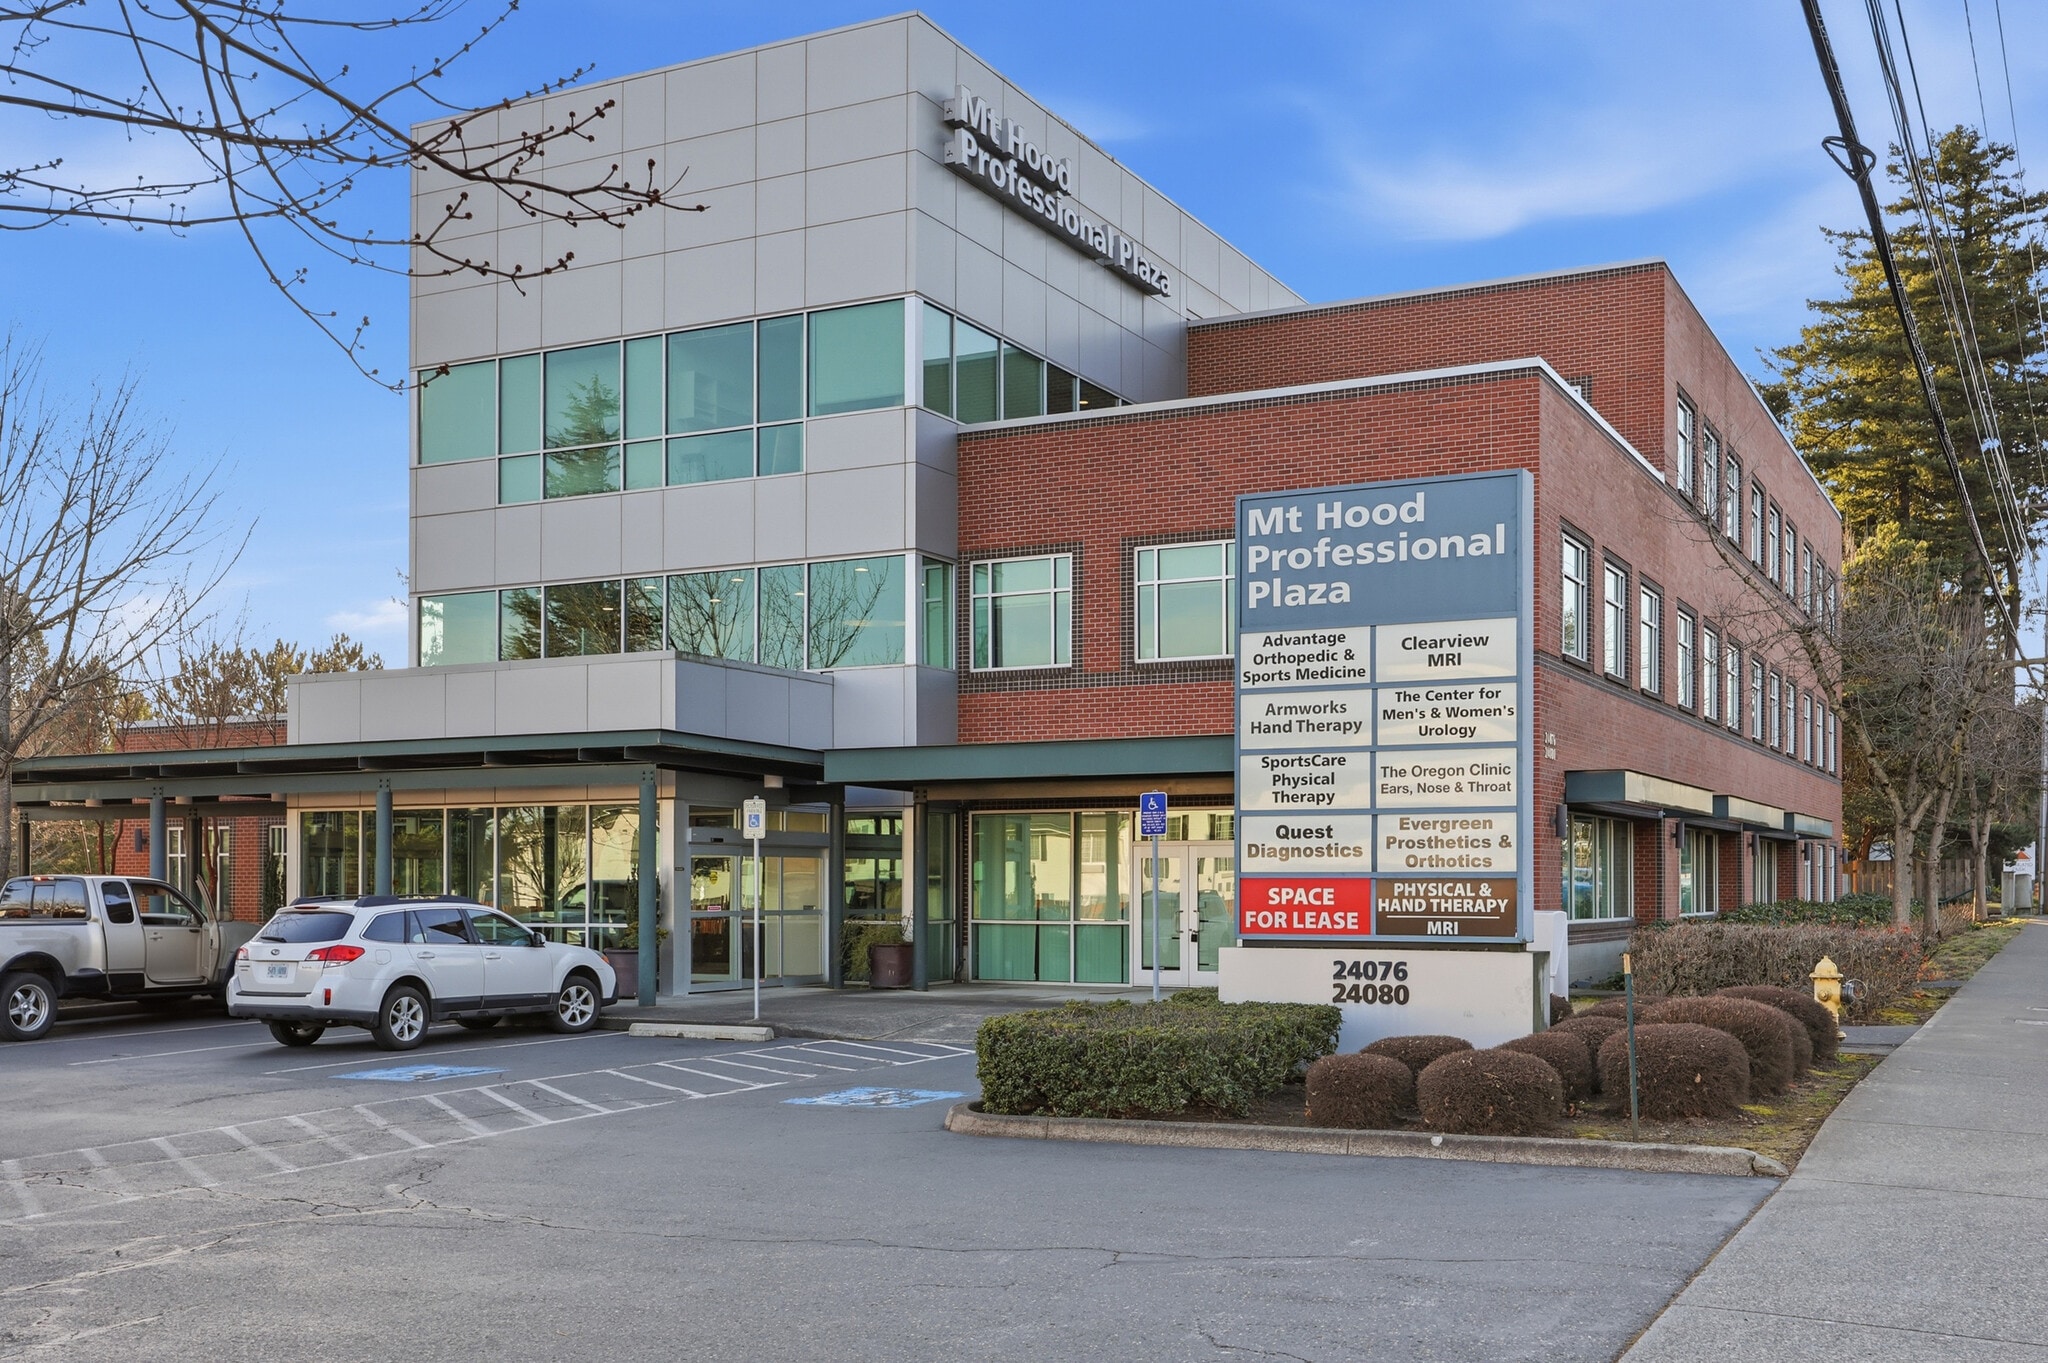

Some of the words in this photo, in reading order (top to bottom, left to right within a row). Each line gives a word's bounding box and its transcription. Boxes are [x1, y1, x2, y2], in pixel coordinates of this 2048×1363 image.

[956, 84, 1001, 148] Mt
[1003, 118, 1071, 195] Hood
[955, 128, 1113, 260] Professional
[1114, 235, 1171, 296] Plaza
[1248, 506, 1302, 536] Mt
[1316, 491, 1425, 530] Hood
[1248, 523, 1505, 573] Professional
[1248, 578, 1351, 608] Plaza
[1262, 632, 1346, 647] Advantage
[1401, 634, 1489, 650] Clearview
[1253, 650, 1338, 667] Orthopedic
[1344, 649, 1355, 661] &
[1428, 653, 1462, 667] MRI
[1243, 670, 1291, 686] Sports
[1296, 666, 1366, 680] Medicine
[1395, 690, 1420, 702] The
[1425, 689, 1474, 701] Center
[1479, 687, 1502, 699] for
[1265, 700, 1347, 716] Armworks
[1382, 707, 1426, 720] Men's
[1431, 707, 1441, 718] &
[1446, 705, 1515, 718] Women's
[1250, 720, 1293, 734] Hand
[1296, 718, 1363, 734] Therapy
[1418, 723, 1477, 738] Urology
[1261, 755, 1346, 771] SportsCare
[1380, 765, 1407, 778] The
[1411, 764, 1464, 780] Oregon
[1469, 763, 1511, 776] Clinic
[1272, 772, 1335, 789] Physical
[1380, 783, 1413, 796] Ears,
[1417, 782, 1450, 793] Nose
[1455, 782, 1464, 793] &
[1468, 780, 1512, 792] Throat
[1272, 790, 1335, 806] Therapy
[1275, 824, 1333, 841] Quest
[1399, 816, 1493, 833] Evergreen
[1386, 835, 1491, 850] Prosthetics
[1498, 835, 1512, 848] &
[1247, 843, 1363, 862] Diagnostics
[1405, 854, 1493, 868] Orthotics
[1268, 888, 1335, 906] SPACE
[1393, 882, 1475, 897] PHYSICAL
[1479, 883, 1492, 896] &
[1378, 899, 1426, 913] HAND
[1430, 898, 1508, 913] THERAPY
[1245, 912, 1287, 928] FOR
[1293, 912, 1359, 929] LEASE
[1427, 922, 1458, 935] MRI
[1333, 960, 1408, 981] 24076
[1332, 983, 1409, 1005] 24080
